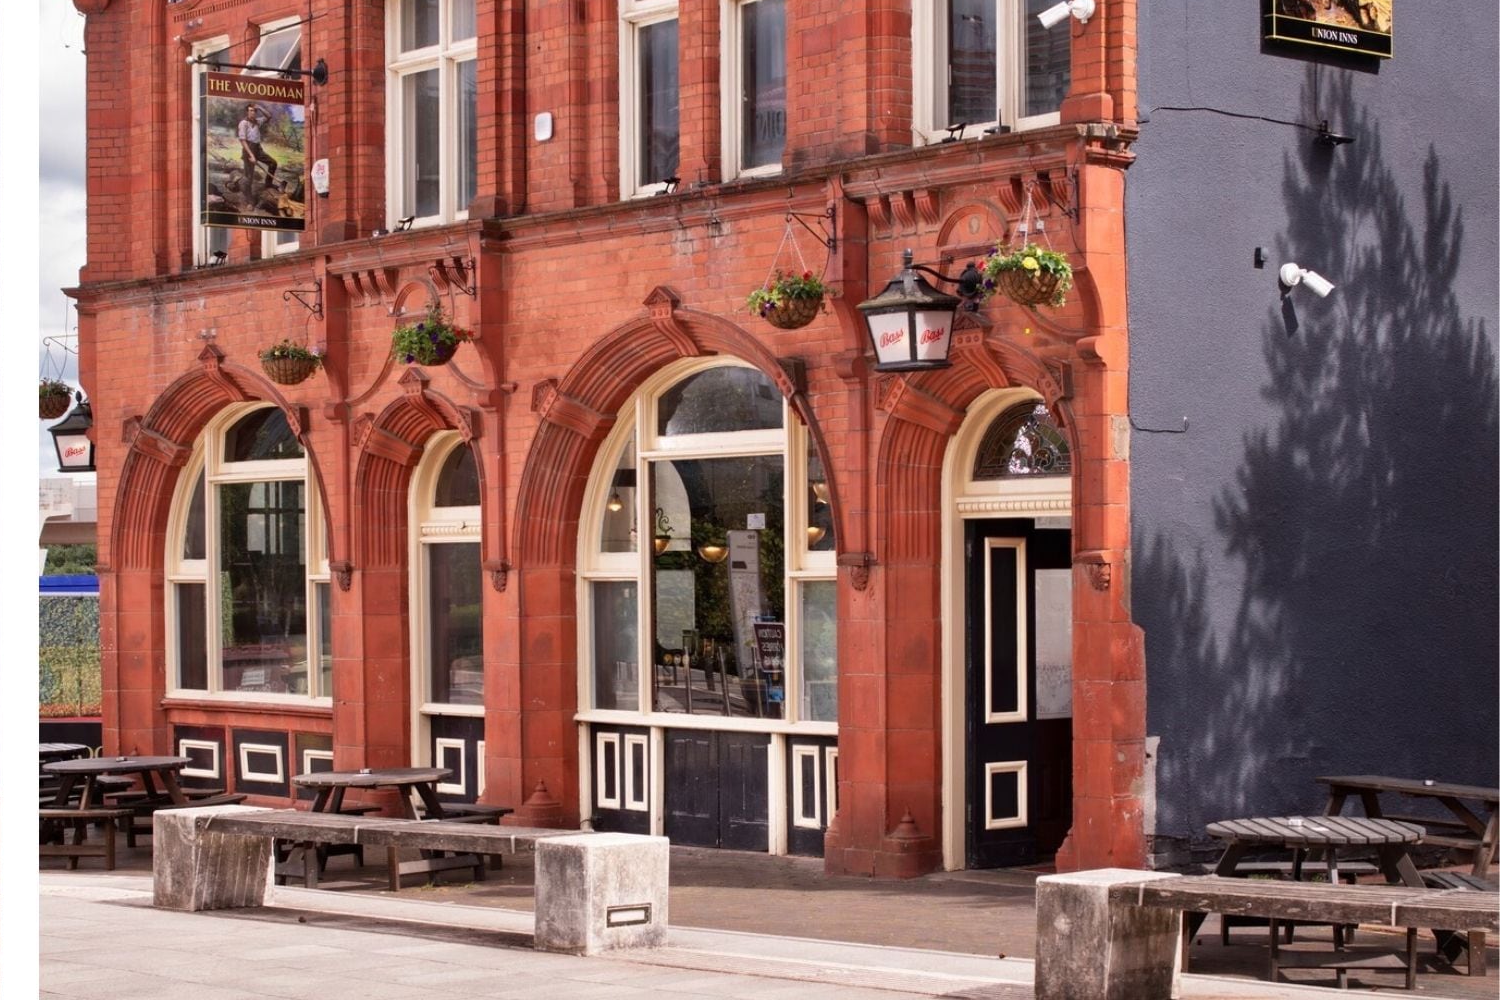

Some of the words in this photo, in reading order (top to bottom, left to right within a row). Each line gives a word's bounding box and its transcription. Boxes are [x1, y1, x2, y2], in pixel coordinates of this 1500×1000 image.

[1311, 27, 1338, 41] UNION
[1338, 31, 1358, 45] INNS
[208, 78, 231, 92] THE
[235, 81, 304, 99] WOODMAN
[237, 215, 260, 225] UNION
[880, 328, 904, 348] Bass
[920, 326, 945, 345] Bass
